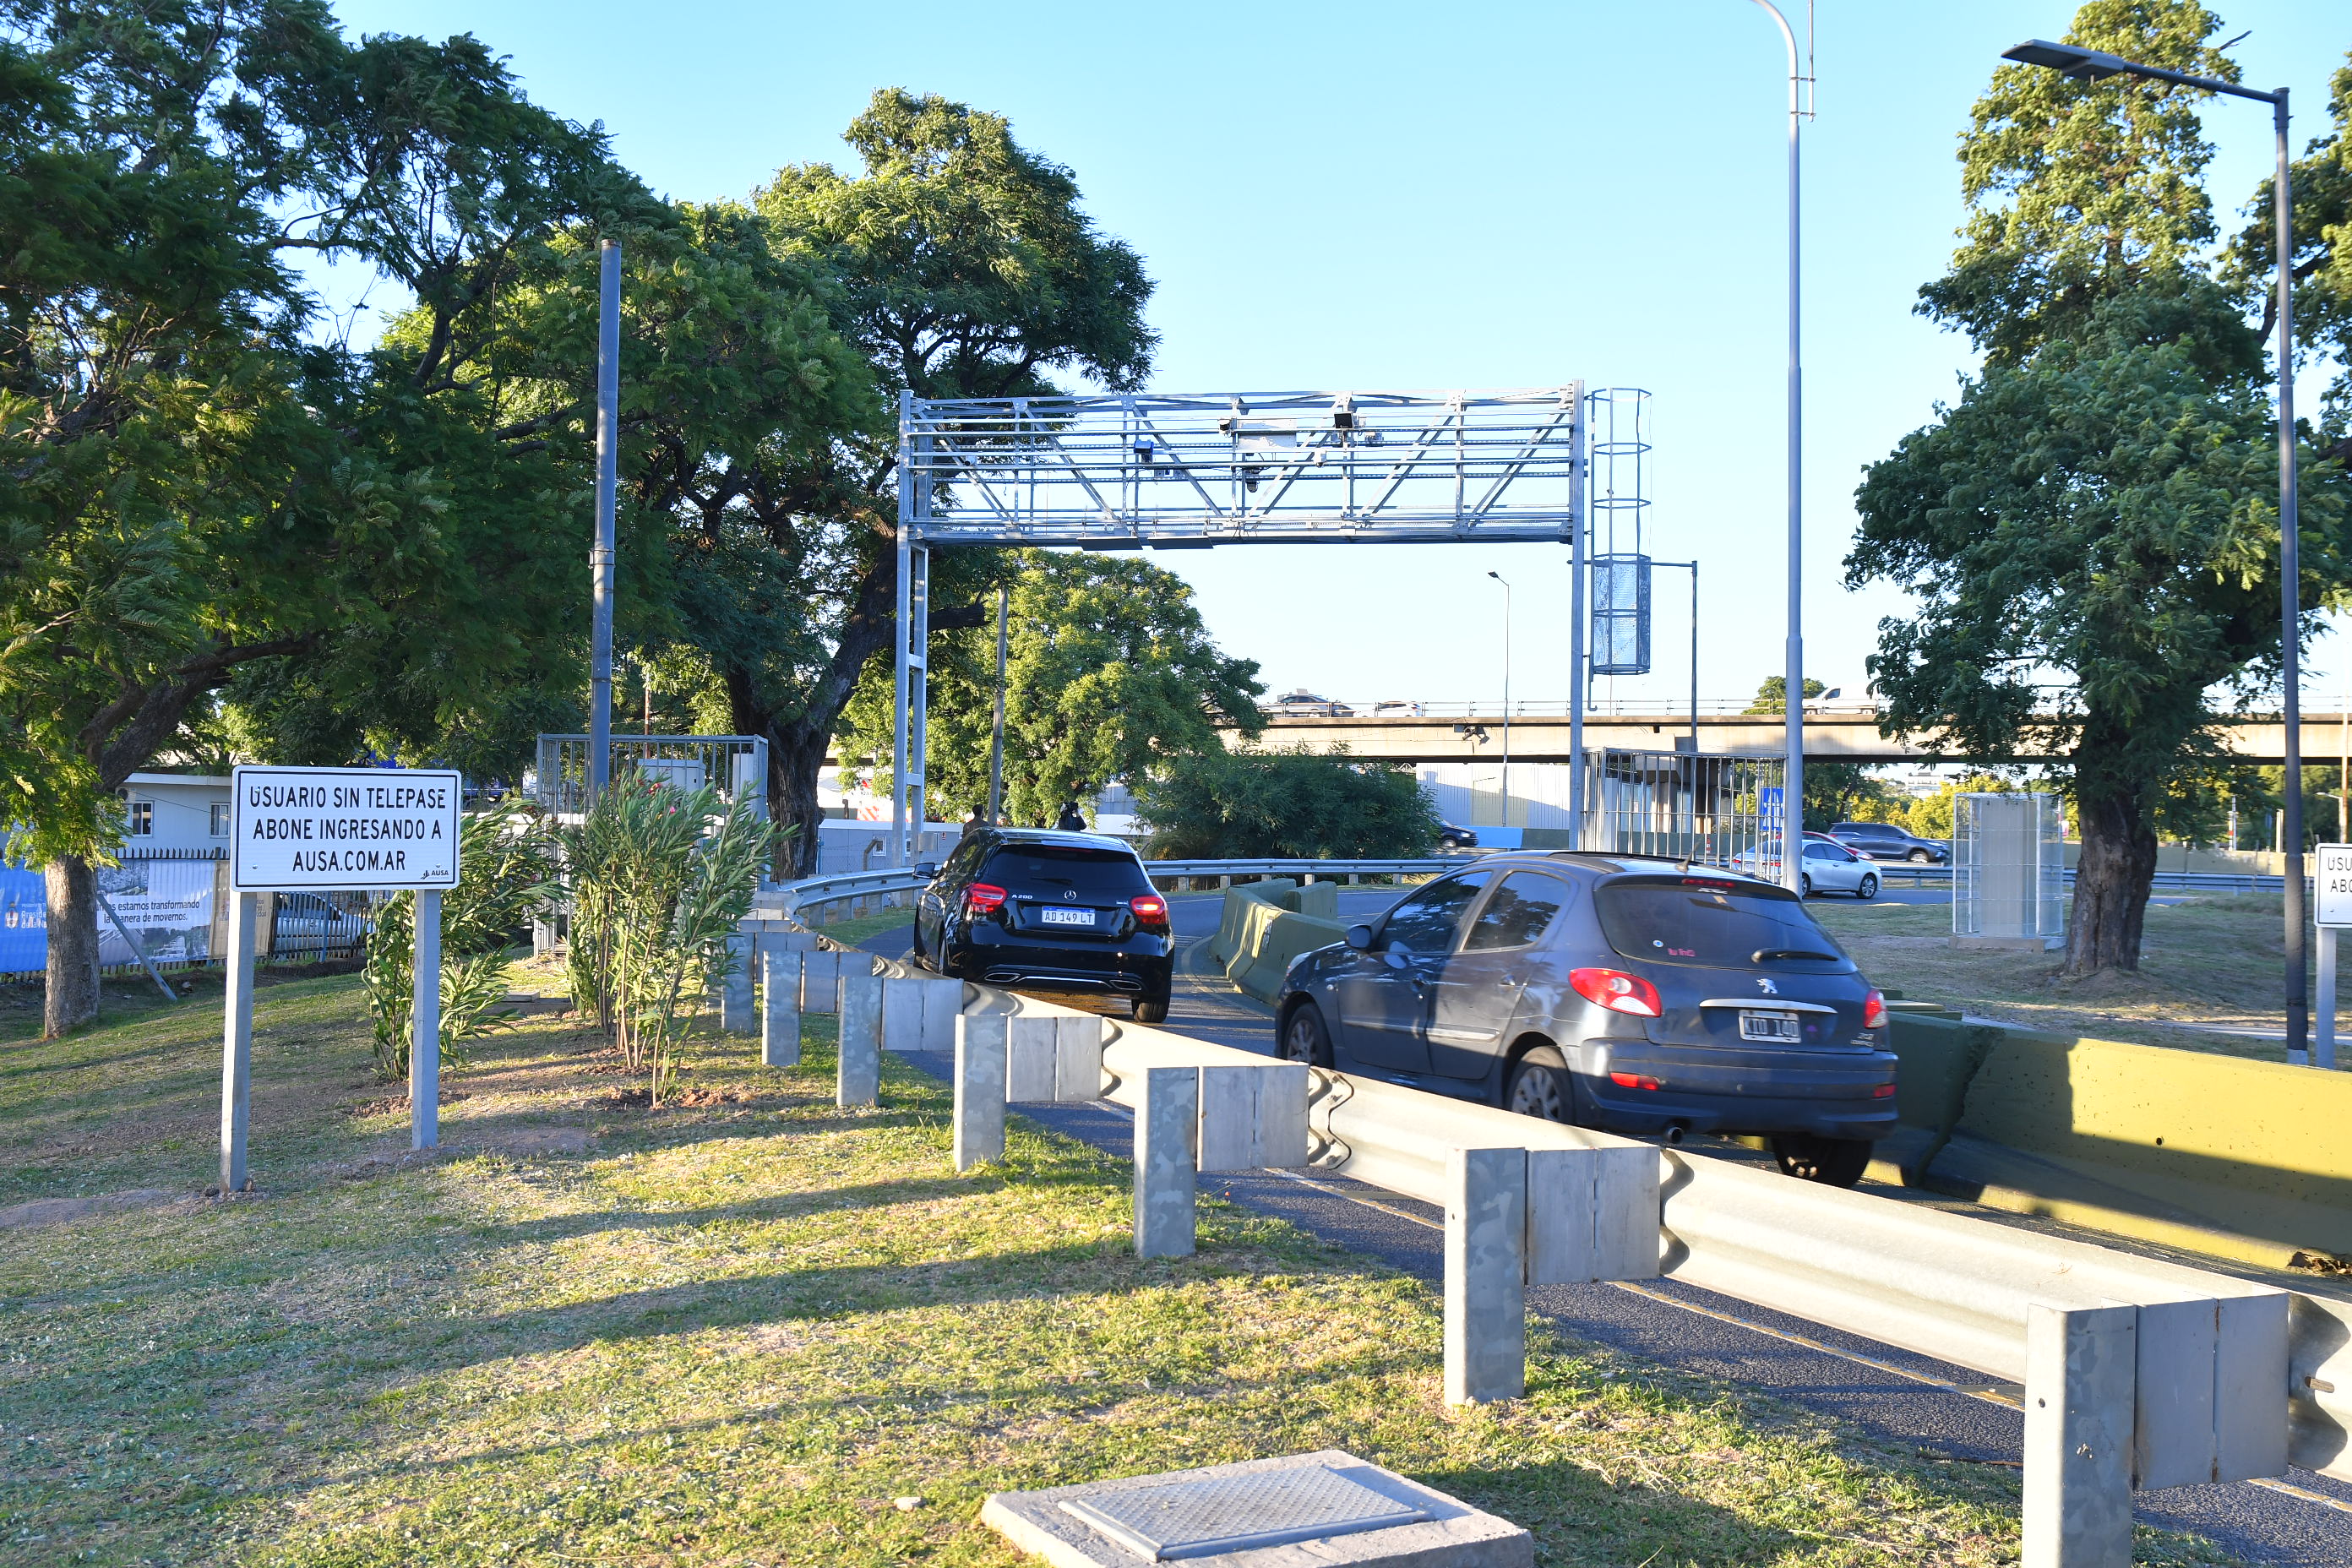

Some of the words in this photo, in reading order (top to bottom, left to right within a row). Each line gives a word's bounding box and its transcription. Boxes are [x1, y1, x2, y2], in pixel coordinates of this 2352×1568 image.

[250, 786, 326, 808] USUARIO
[333, 787, 360, 808] SIN
[366, 787, 446, 808] TELEPASE
[253, 818, 313, 840] ABONE
[319, 819, 425, 840] INGRESANDO
[431, 819, 442, 840] A
[292, 850, 406, 872] AUSA.COM.AR
[118, 901, 150, 911] estamos
[150, 899, 200, 911] transformando
[104, 913, 111, 923] la
[115, 915, 141, 923] anera
[142, 912, 152, 923] de
[153, 912, 188, 923] movernos.
[1044, 912, 1057, 922] AD
[1059, 912, 1078, 922] 149
[1081, 913, 1092, 923] LT
